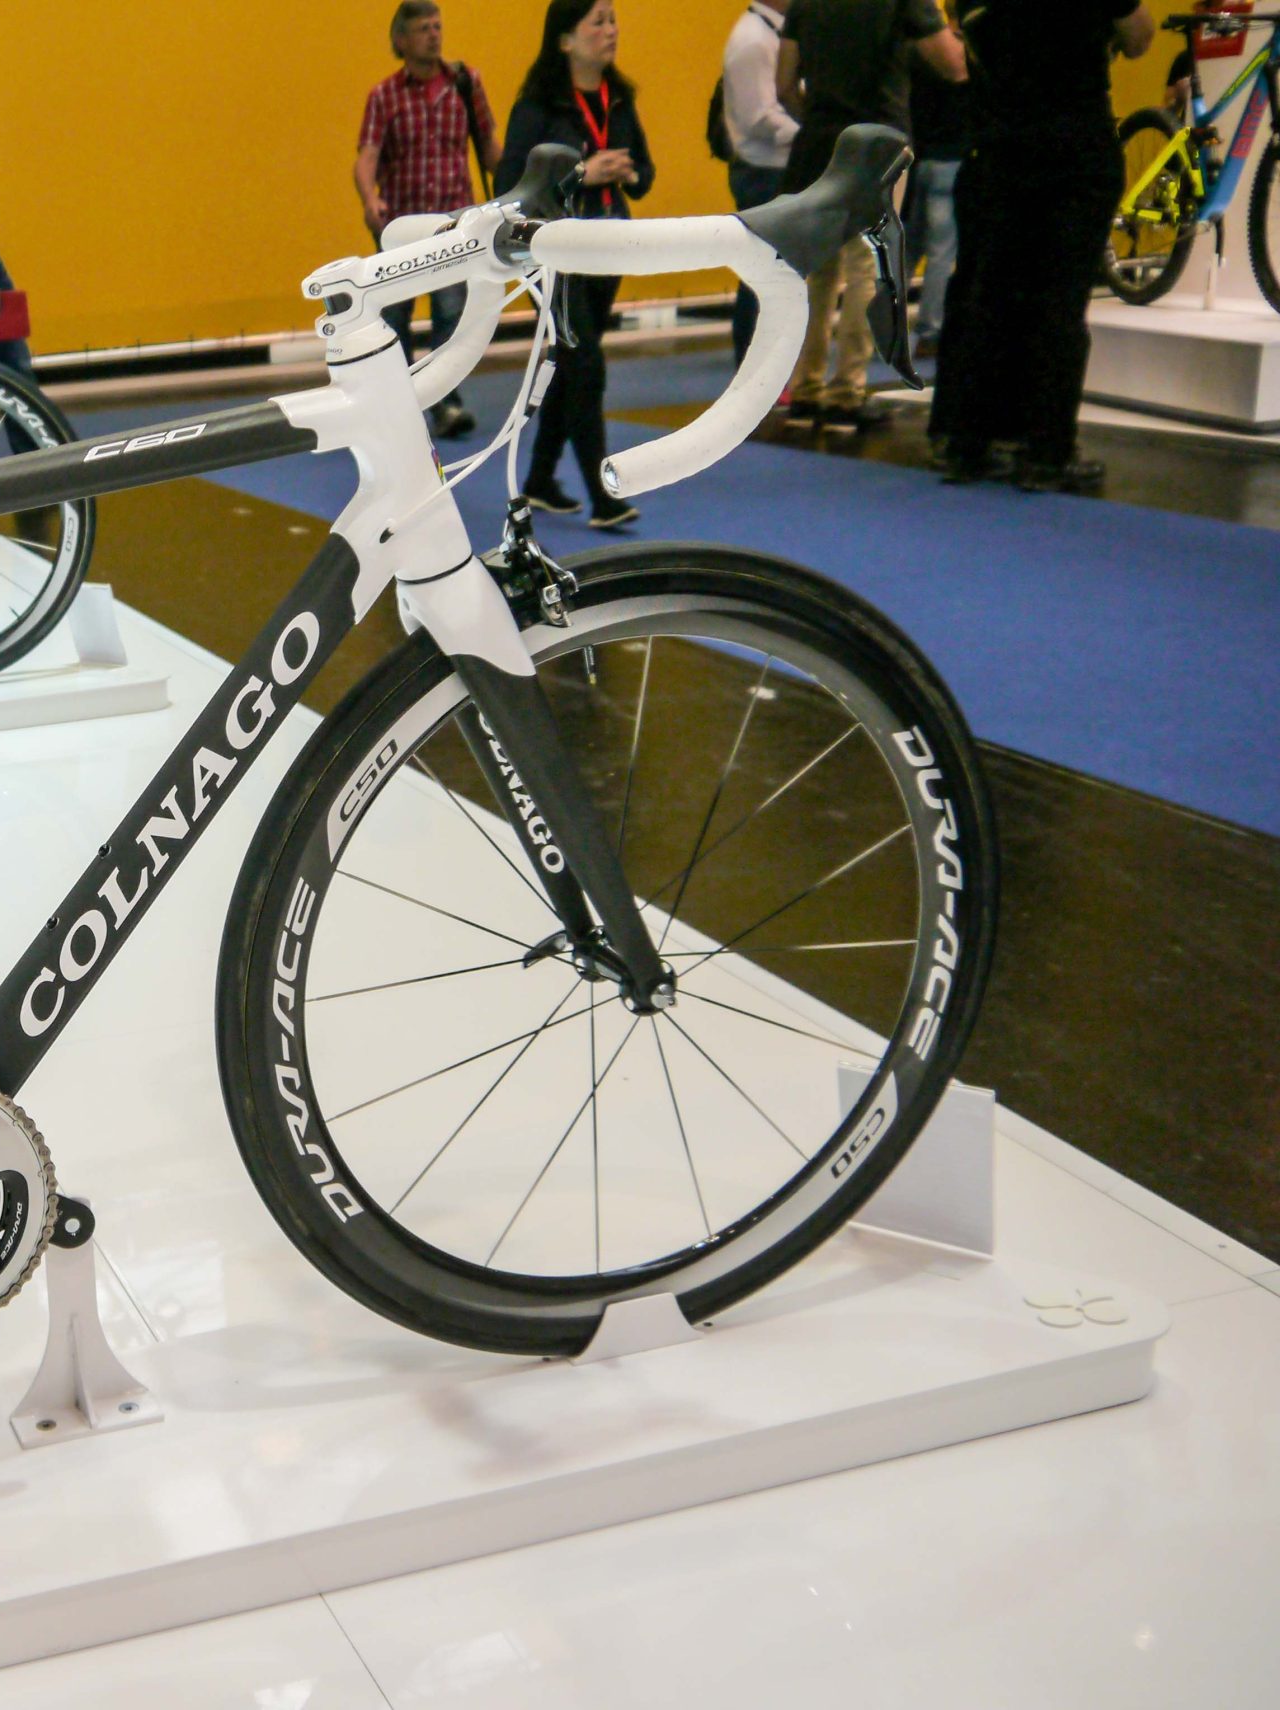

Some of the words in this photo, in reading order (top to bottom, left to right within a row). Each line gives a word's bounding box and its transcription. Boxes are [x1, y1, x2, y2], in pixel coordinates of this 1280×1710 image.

[386, 238, 480, 277] COLNAGO
[84, 423, 207, 463] C60
[340, 739, 398, 822] C50
[19, 611, 320, 1038] COLNAGO
[892, 726, 963, 1060] DURA-ACE
[272, 876, 364, 1223] DURA-ACE
[831, 1107, 885, 1179] C50
[0, 1202, 23, 1261] DURA-ACE
